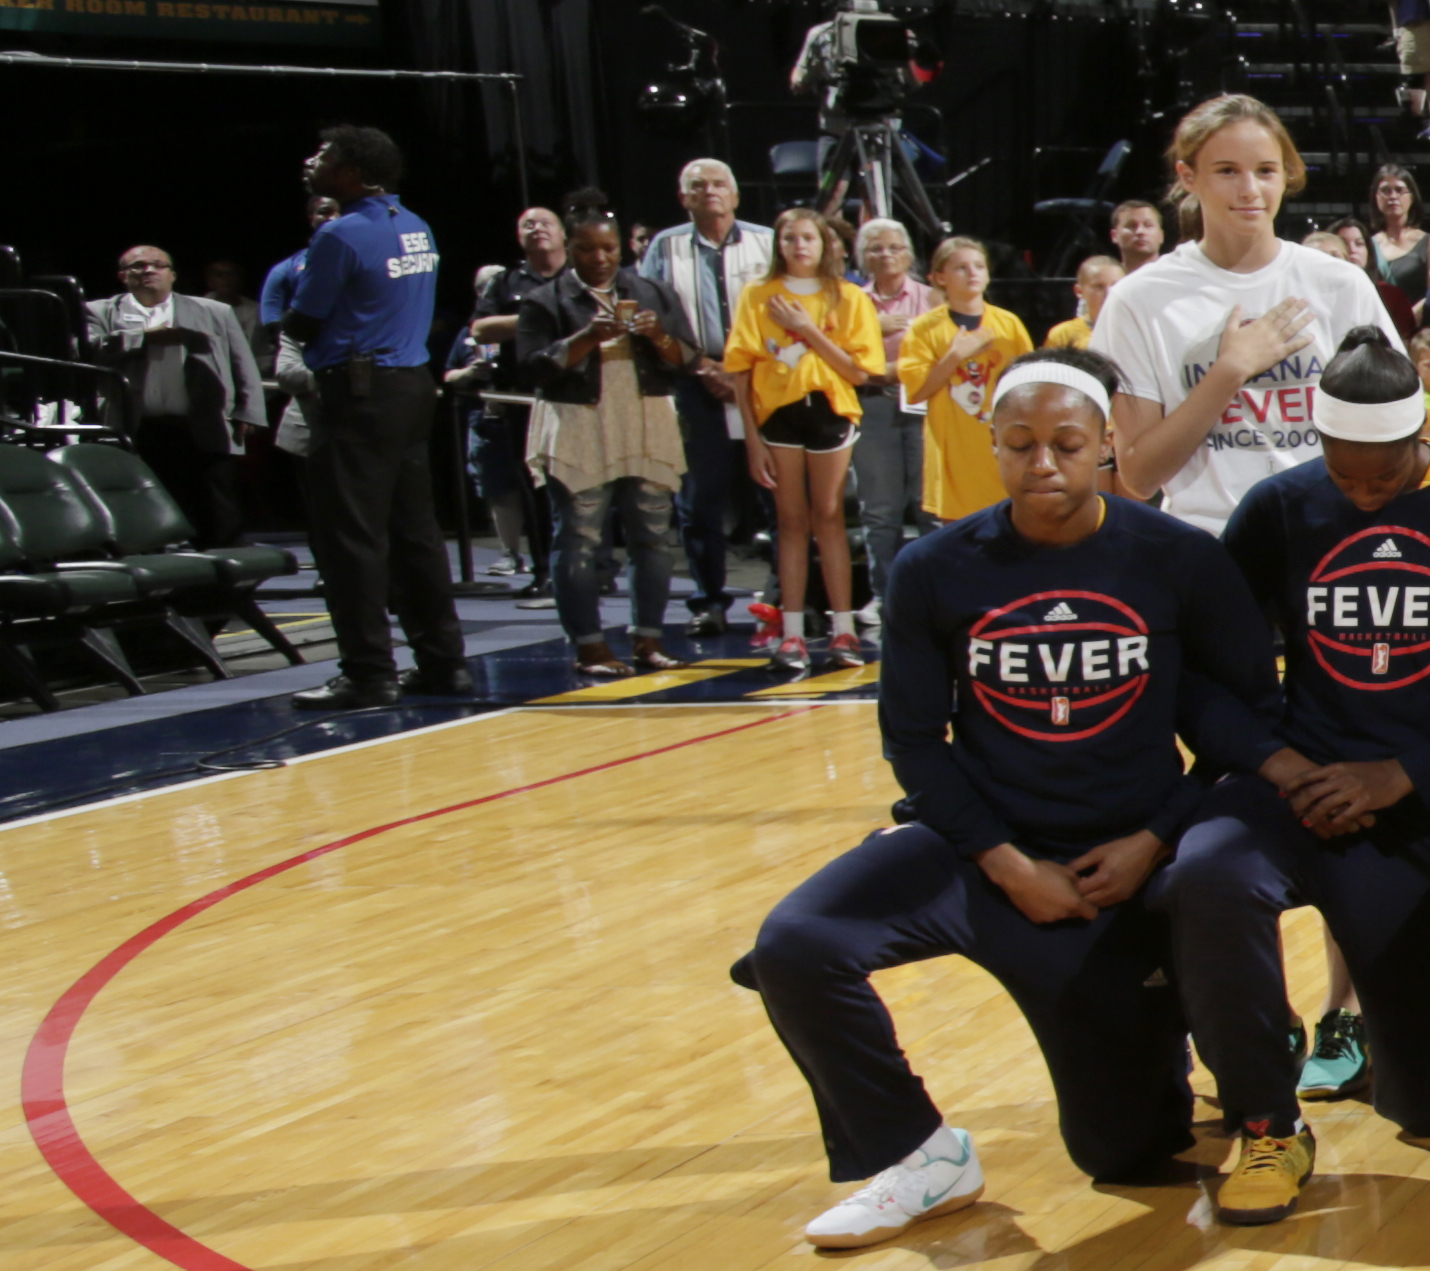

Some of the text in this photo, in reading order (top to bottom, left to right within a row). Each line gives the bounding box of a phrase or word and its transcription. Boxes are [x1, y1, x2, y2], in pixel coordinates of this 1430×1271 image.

[157, 1, 341, 25] RESTAURANT
[401, 231, 429, 252] ESG
[1184, 352, 1326, 378] INANA
[1221, 385, 1321, 426] EVE
[1272, 429, 1320, 448] 200
[1372, 551, 1402, 559] adidas
[1045, 613, 1078, 622] adidas
[1338, 632, 1428, 642] BASKETBALL
[968, 635, 1151, 683] FEVER
[1006, 684, 1112, 696] BASKETBALL
